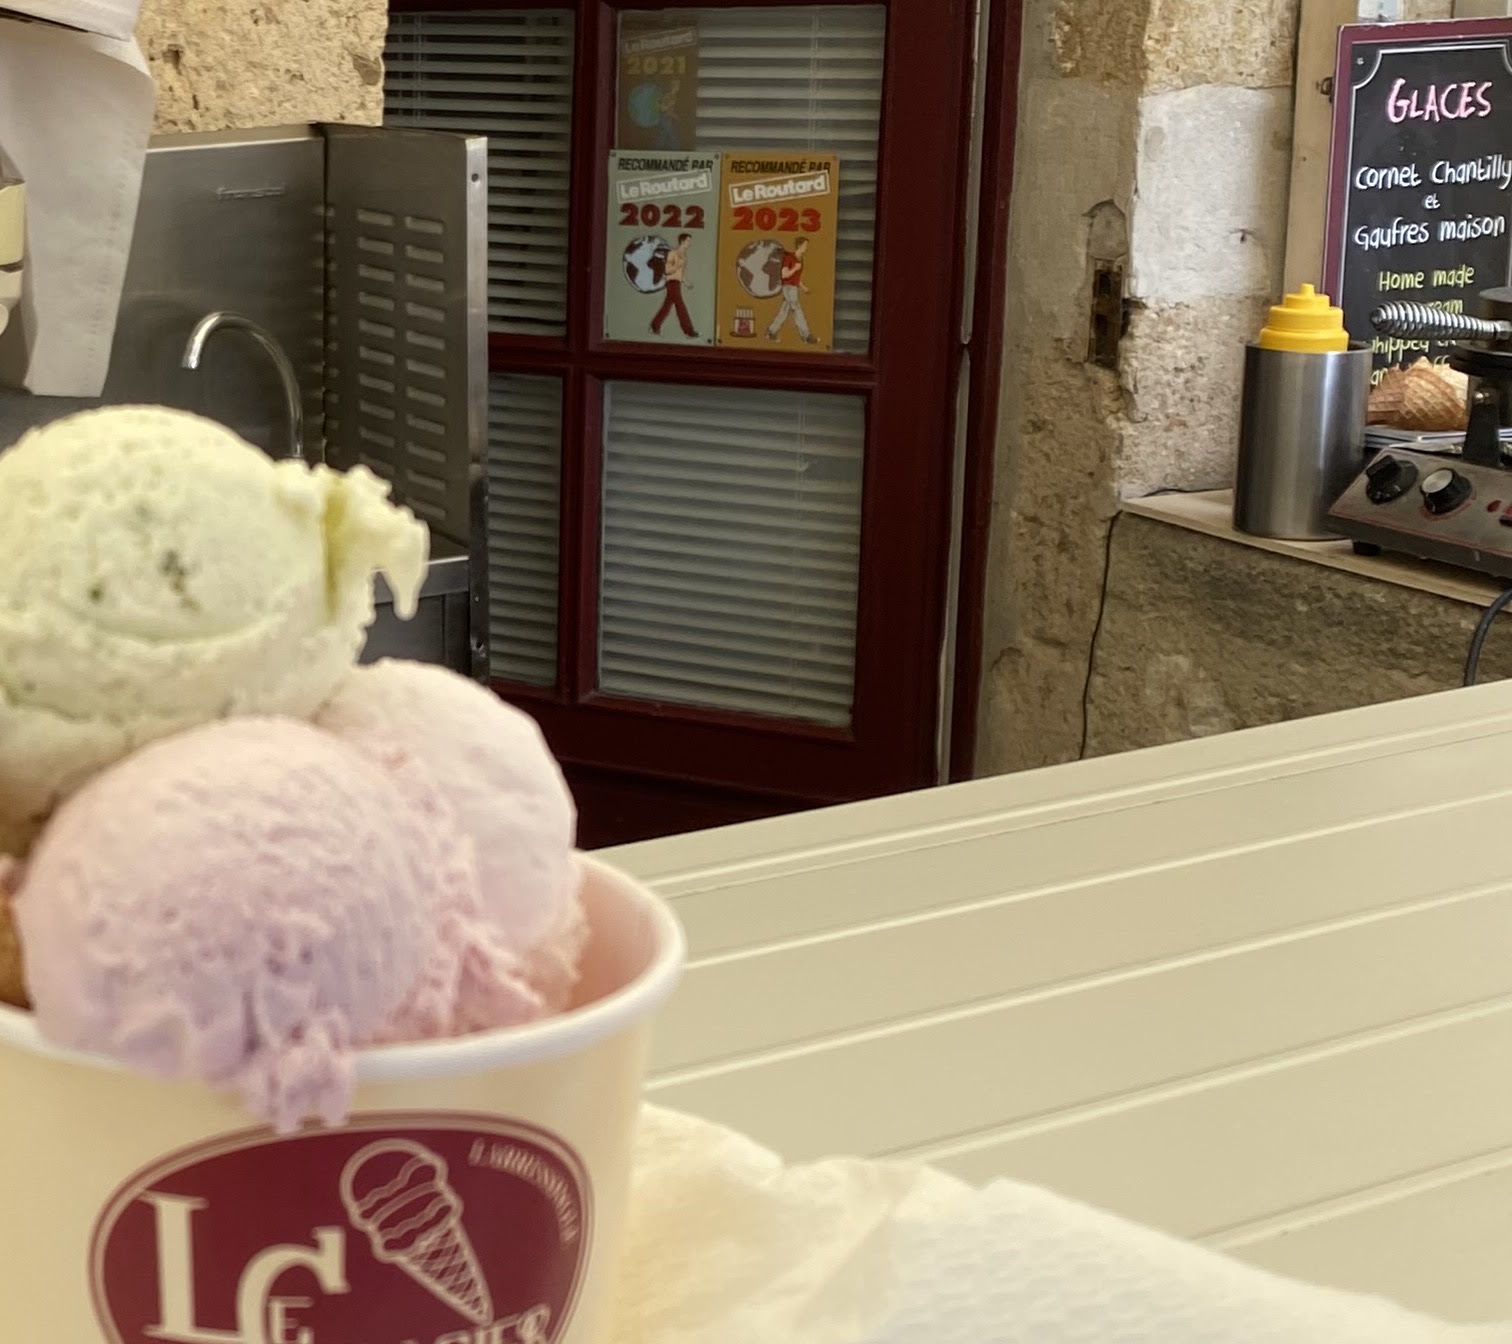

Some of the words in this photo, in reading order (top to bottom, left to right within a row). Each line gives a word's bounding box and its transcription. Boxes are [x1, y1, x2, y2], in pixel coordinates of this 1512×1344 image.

[1387, 77, 1493, 124] GLACES
[617, 157, 691, 172] RECOMMANDÉ
[730, 158, 808, 175] RECOMMANDÉ
[1355, 162, 1422, 191] Cornet
[1431, 154, 1512, 190] Chantilly
[1424, 193, 1440, 209] et
[618, 202, 705, 229] 2022
[732, 206, 822, 233] 2023
[1354, 216, 1430, 250] Gaufres
[1440, 214, 1506, 242] maison
[1379, 270, 1425, 292] Home
[1433, 264, 1475, 288] made
